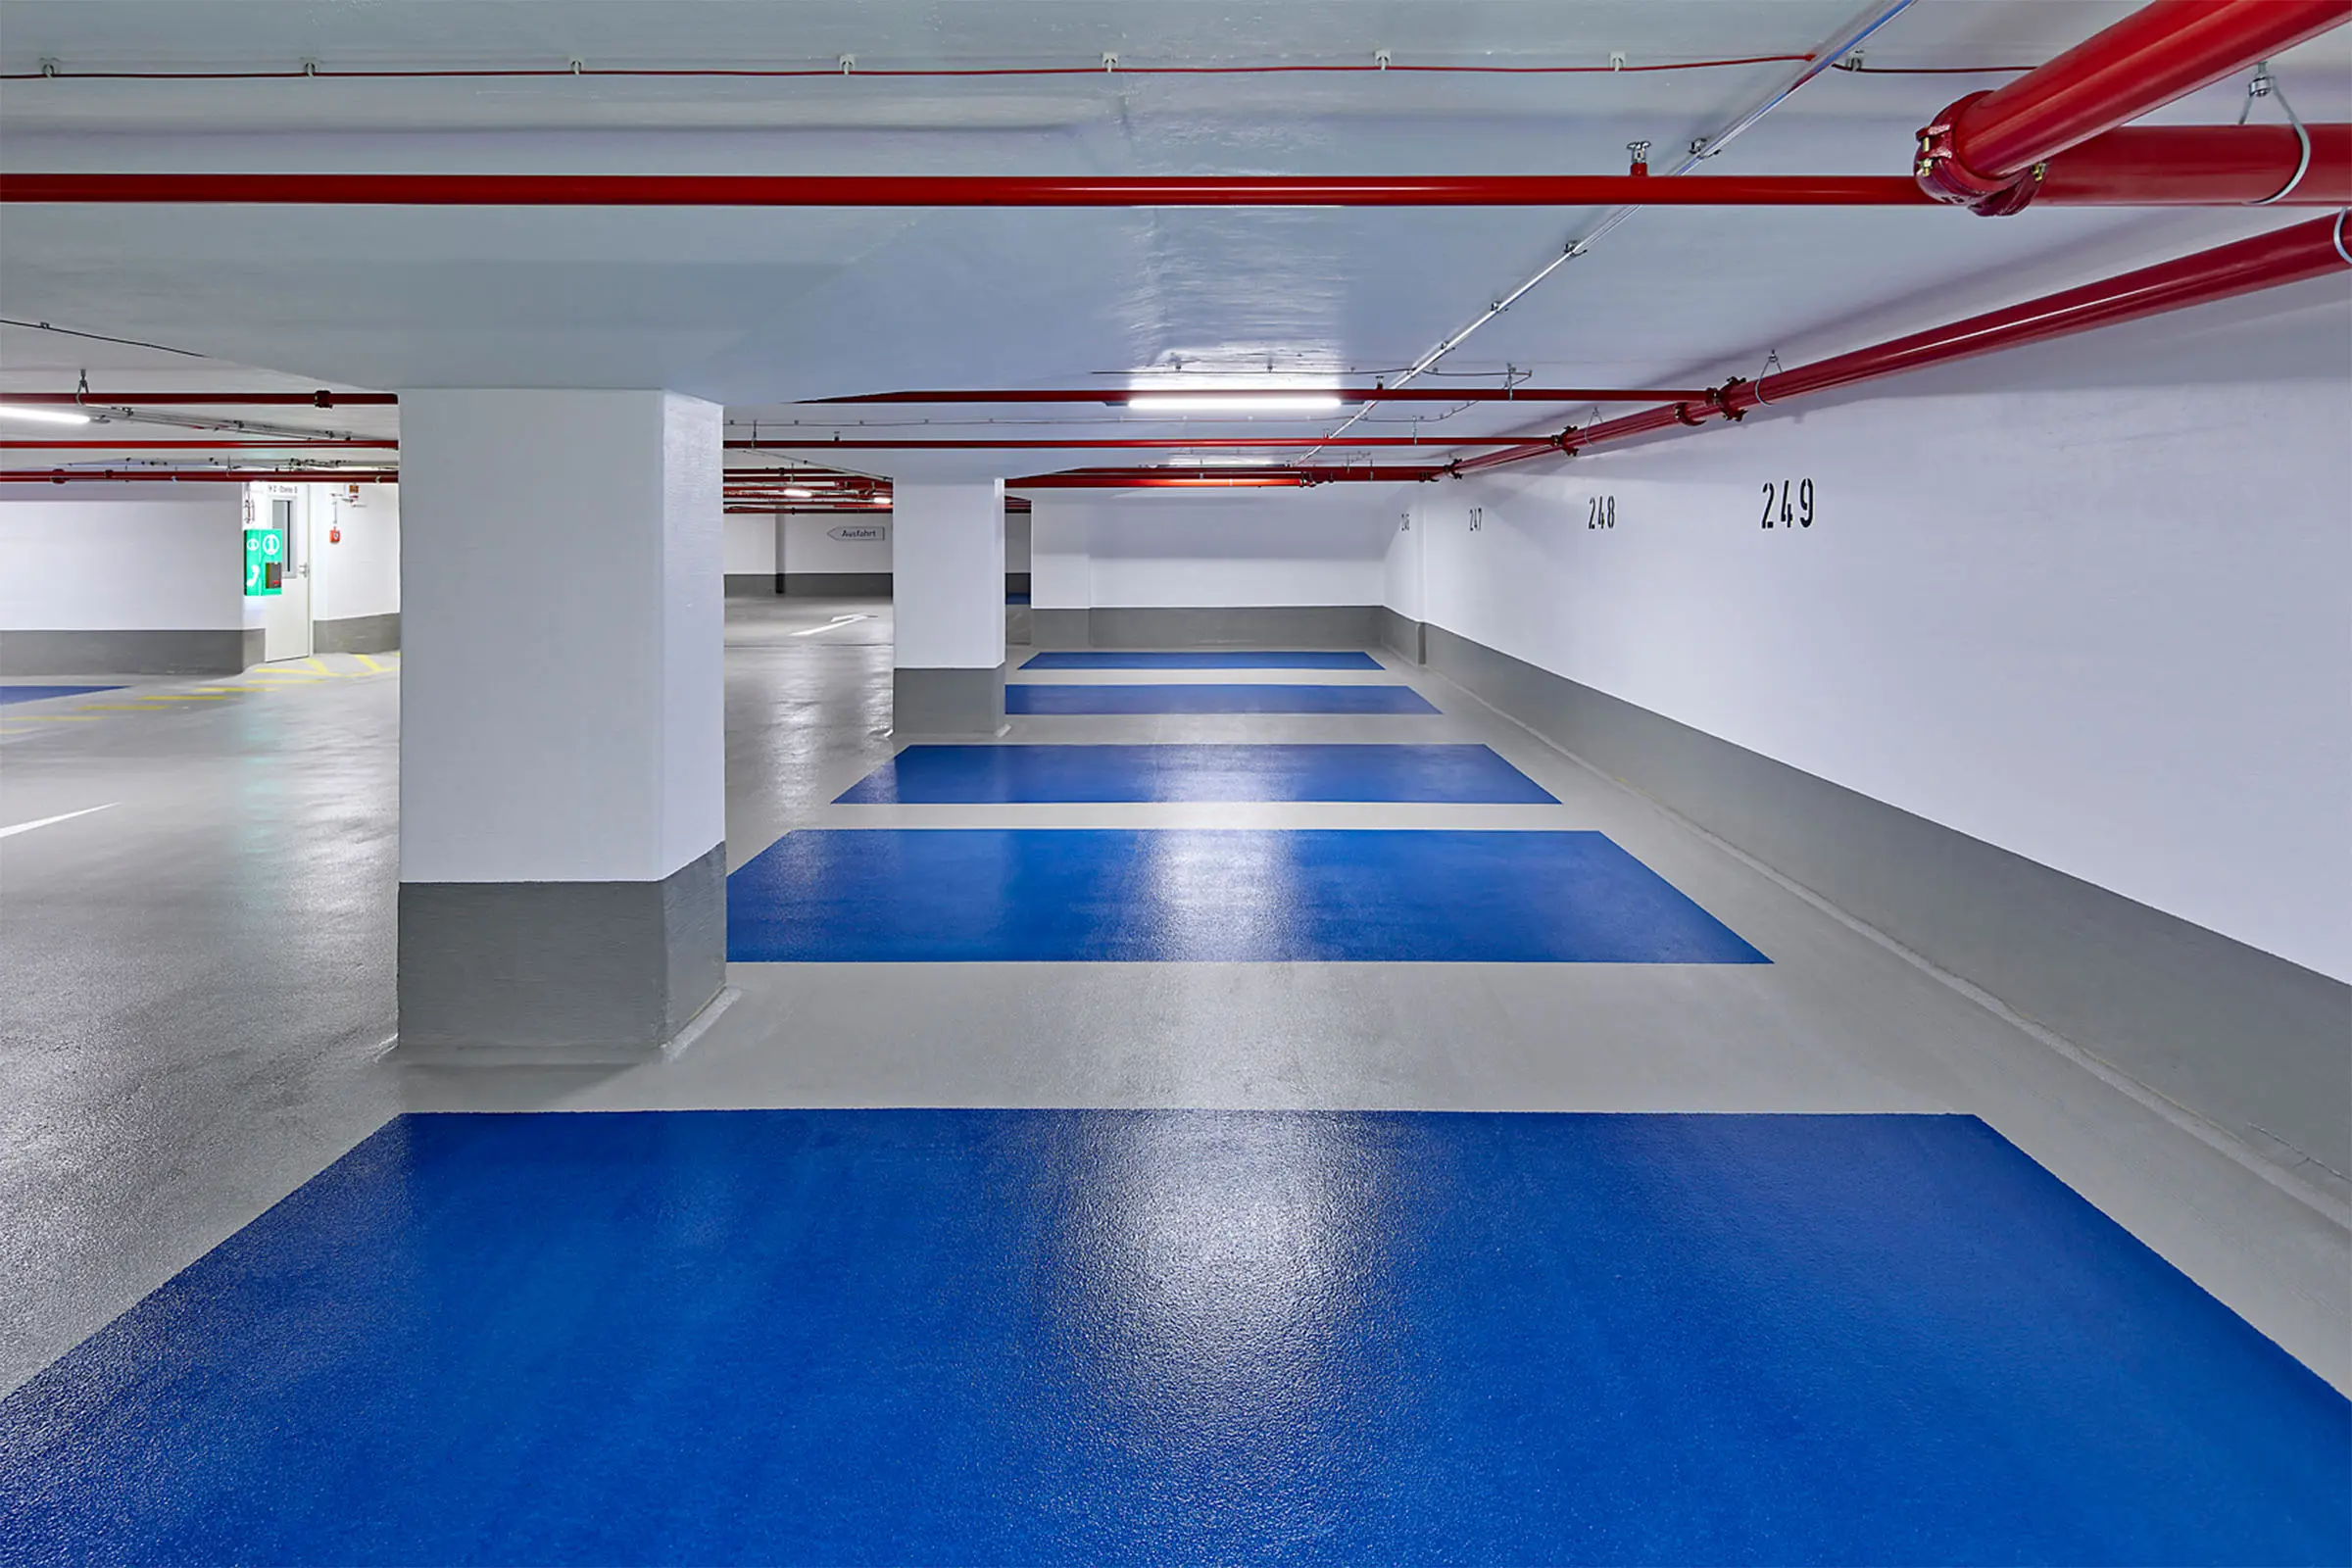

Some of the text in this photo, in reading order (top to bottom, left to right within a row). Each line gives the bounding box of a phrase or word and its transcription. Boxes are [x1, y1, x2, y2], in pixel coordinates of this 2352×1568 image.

[1588, 496, 1615, 529] 248
[1761, 478, 1813, 528] 249
[842, 529, 876, 538] Ausfahrt
[1470, 508, 1482, 531] 247
